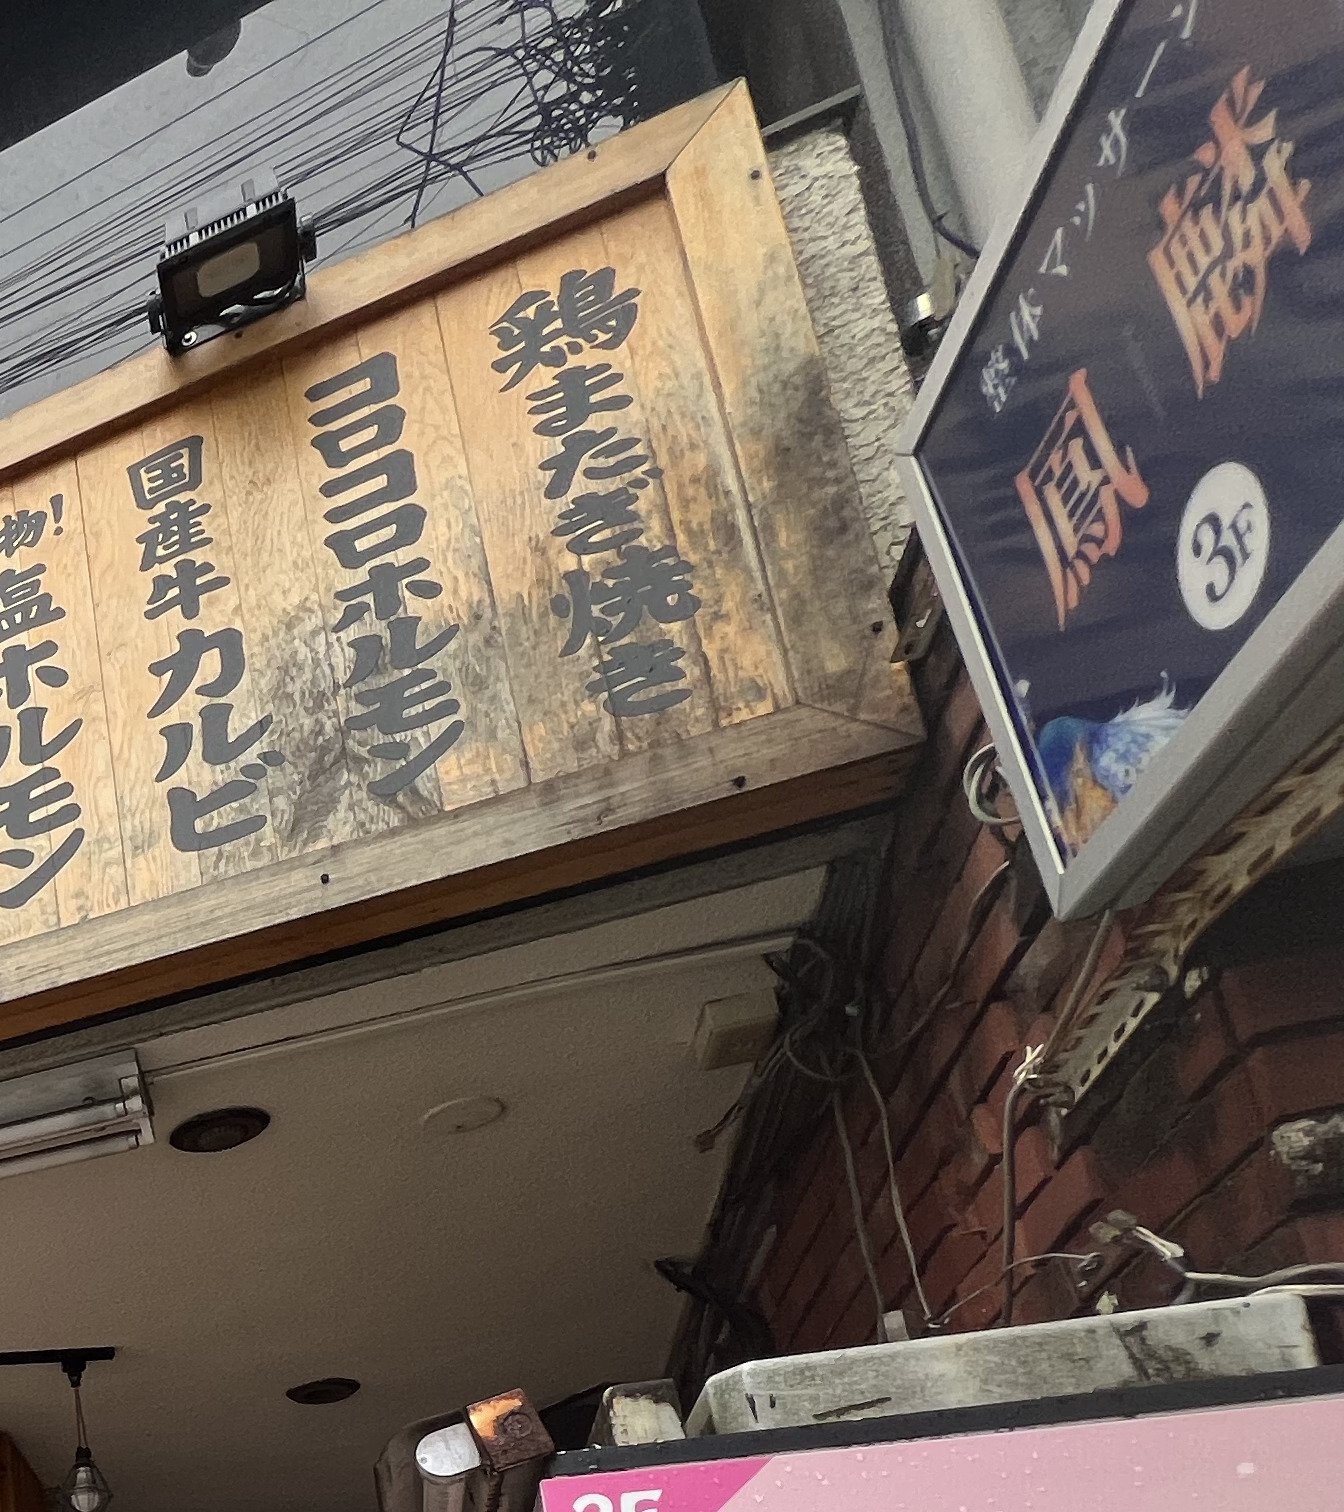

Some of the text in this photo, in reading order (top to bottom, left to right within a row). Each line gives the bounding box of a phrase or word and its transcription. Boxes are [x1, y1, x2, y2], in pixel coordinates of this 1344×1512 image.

[302, 350, 464, 797] コロコロホルモン
[488, 266, 703, 718] 鶏またぎ焼き
[1193, 502, 1254, 604] 3F
